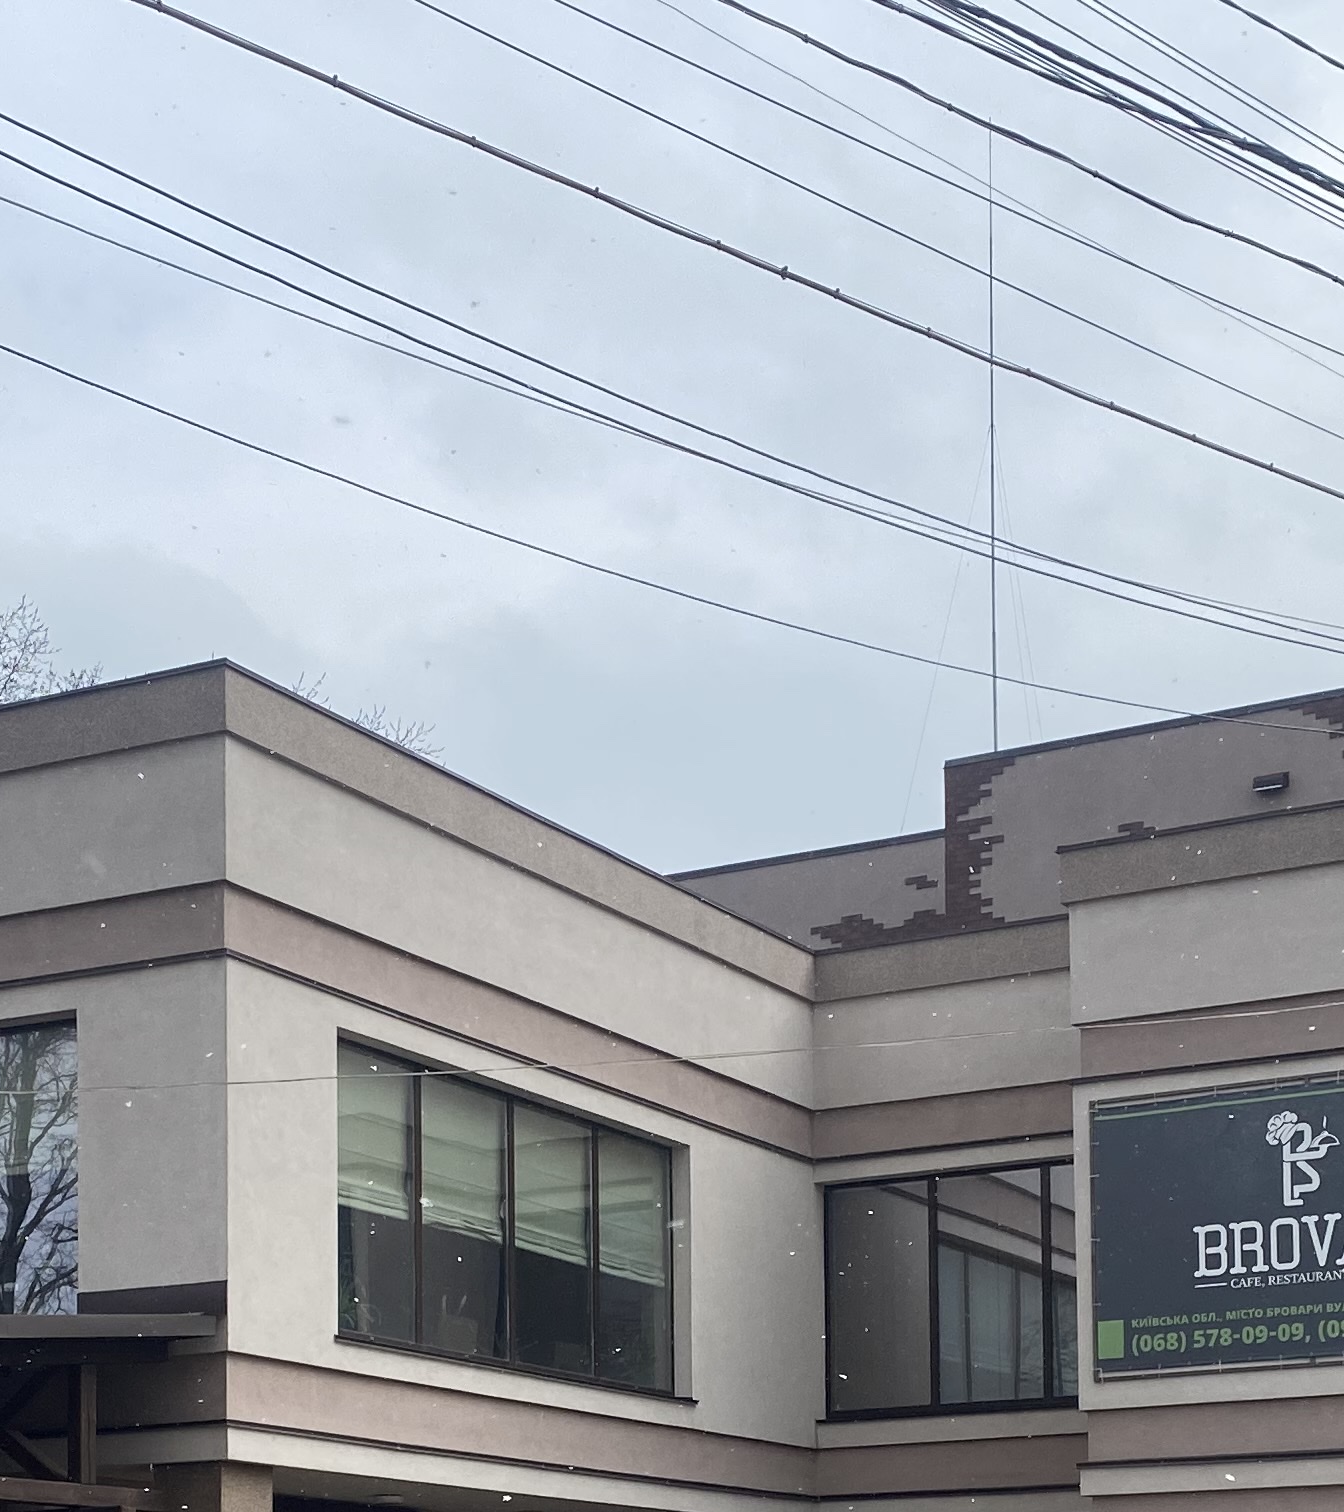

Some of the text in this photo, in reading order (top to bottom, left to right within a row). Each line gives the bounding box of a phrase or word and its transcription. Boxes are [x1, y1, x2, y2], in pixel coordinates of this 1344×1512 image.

[1230, 1276, 1265, 1288] CAFE,
[1131, 1315, 1189, 1328] КИЇВСЬКА
[1226, 1308, 1263, 1321] МІСТО
[1266, 1303, 1323, 1317] БРОВАРИ
[1132, 1331, 1187, 1357] (068)
[1193, 1322, 1311, 1349] 578-09-09,
